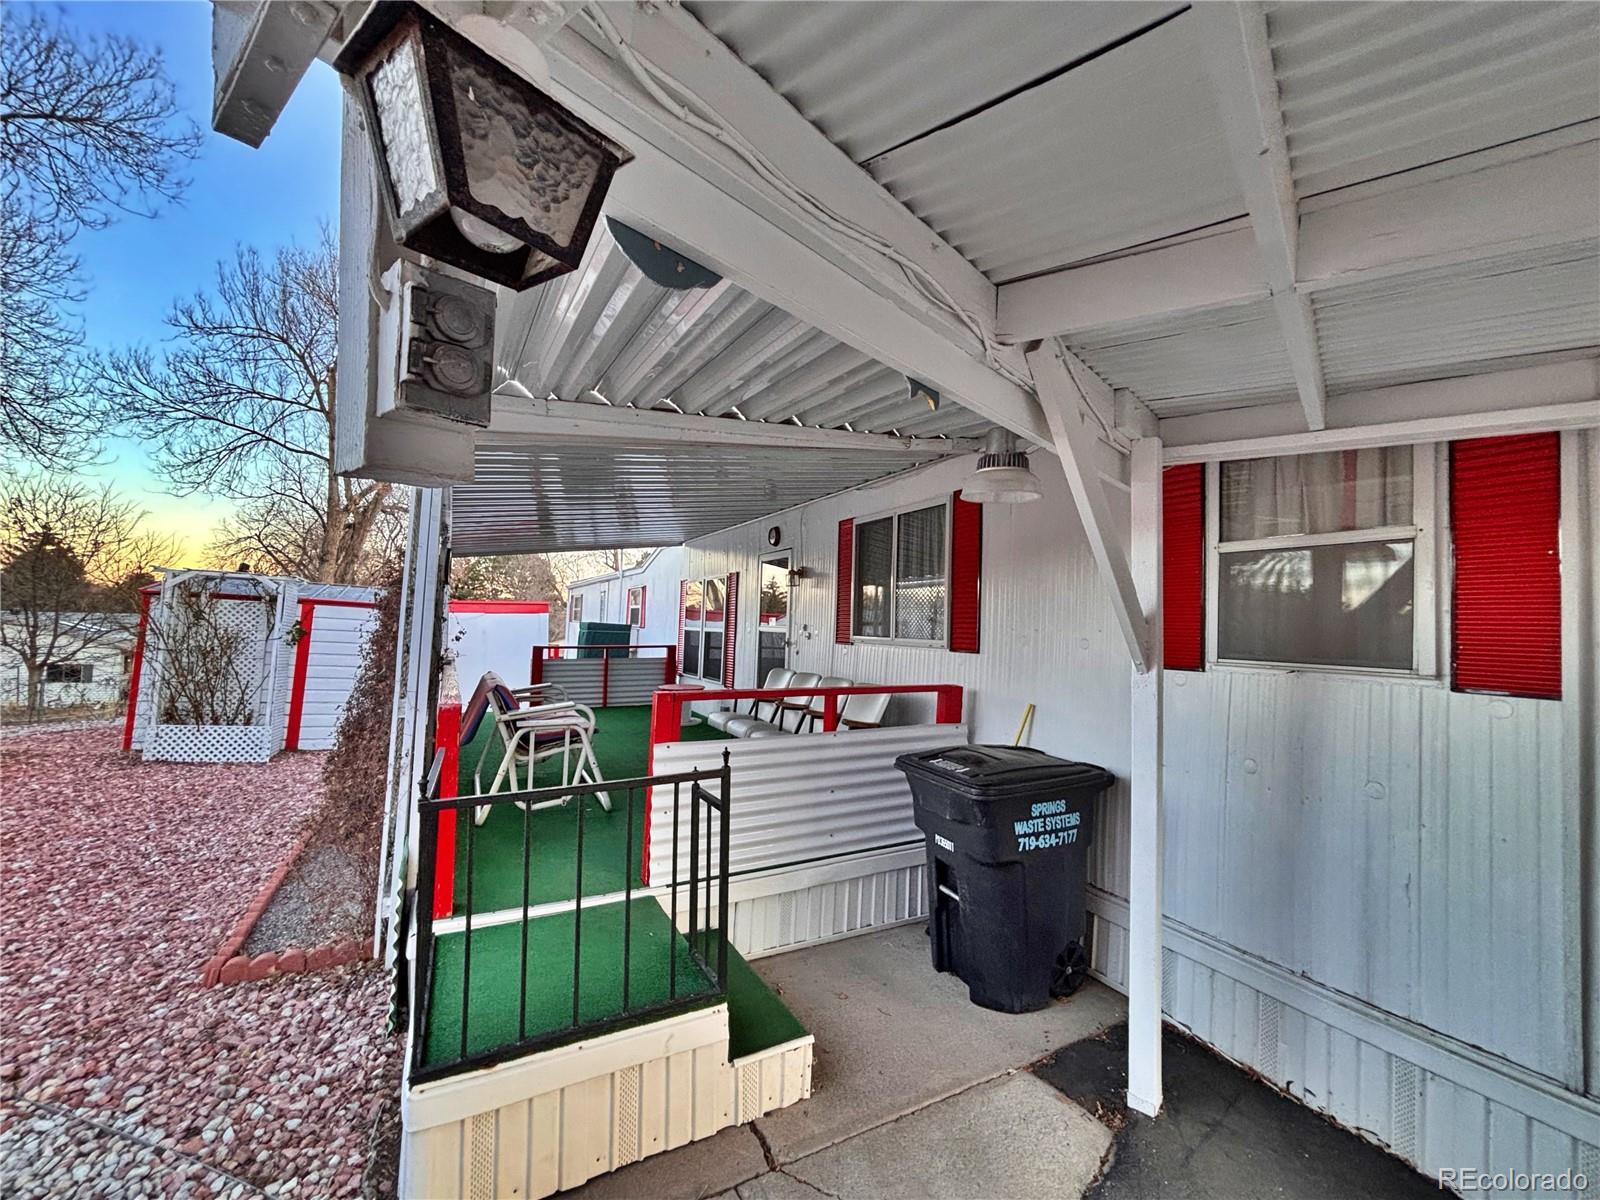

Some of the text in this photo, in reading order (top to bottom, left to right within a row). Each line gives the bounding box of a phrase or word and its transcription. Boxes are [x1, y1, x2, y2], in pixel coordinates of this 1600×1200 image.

[1031, 799, 1066, 817] SPRINGS
[1014, 812, 1081, 836] WASTE SYSTEMS
[1018, 829, 1078, 852] 719-634-7177
